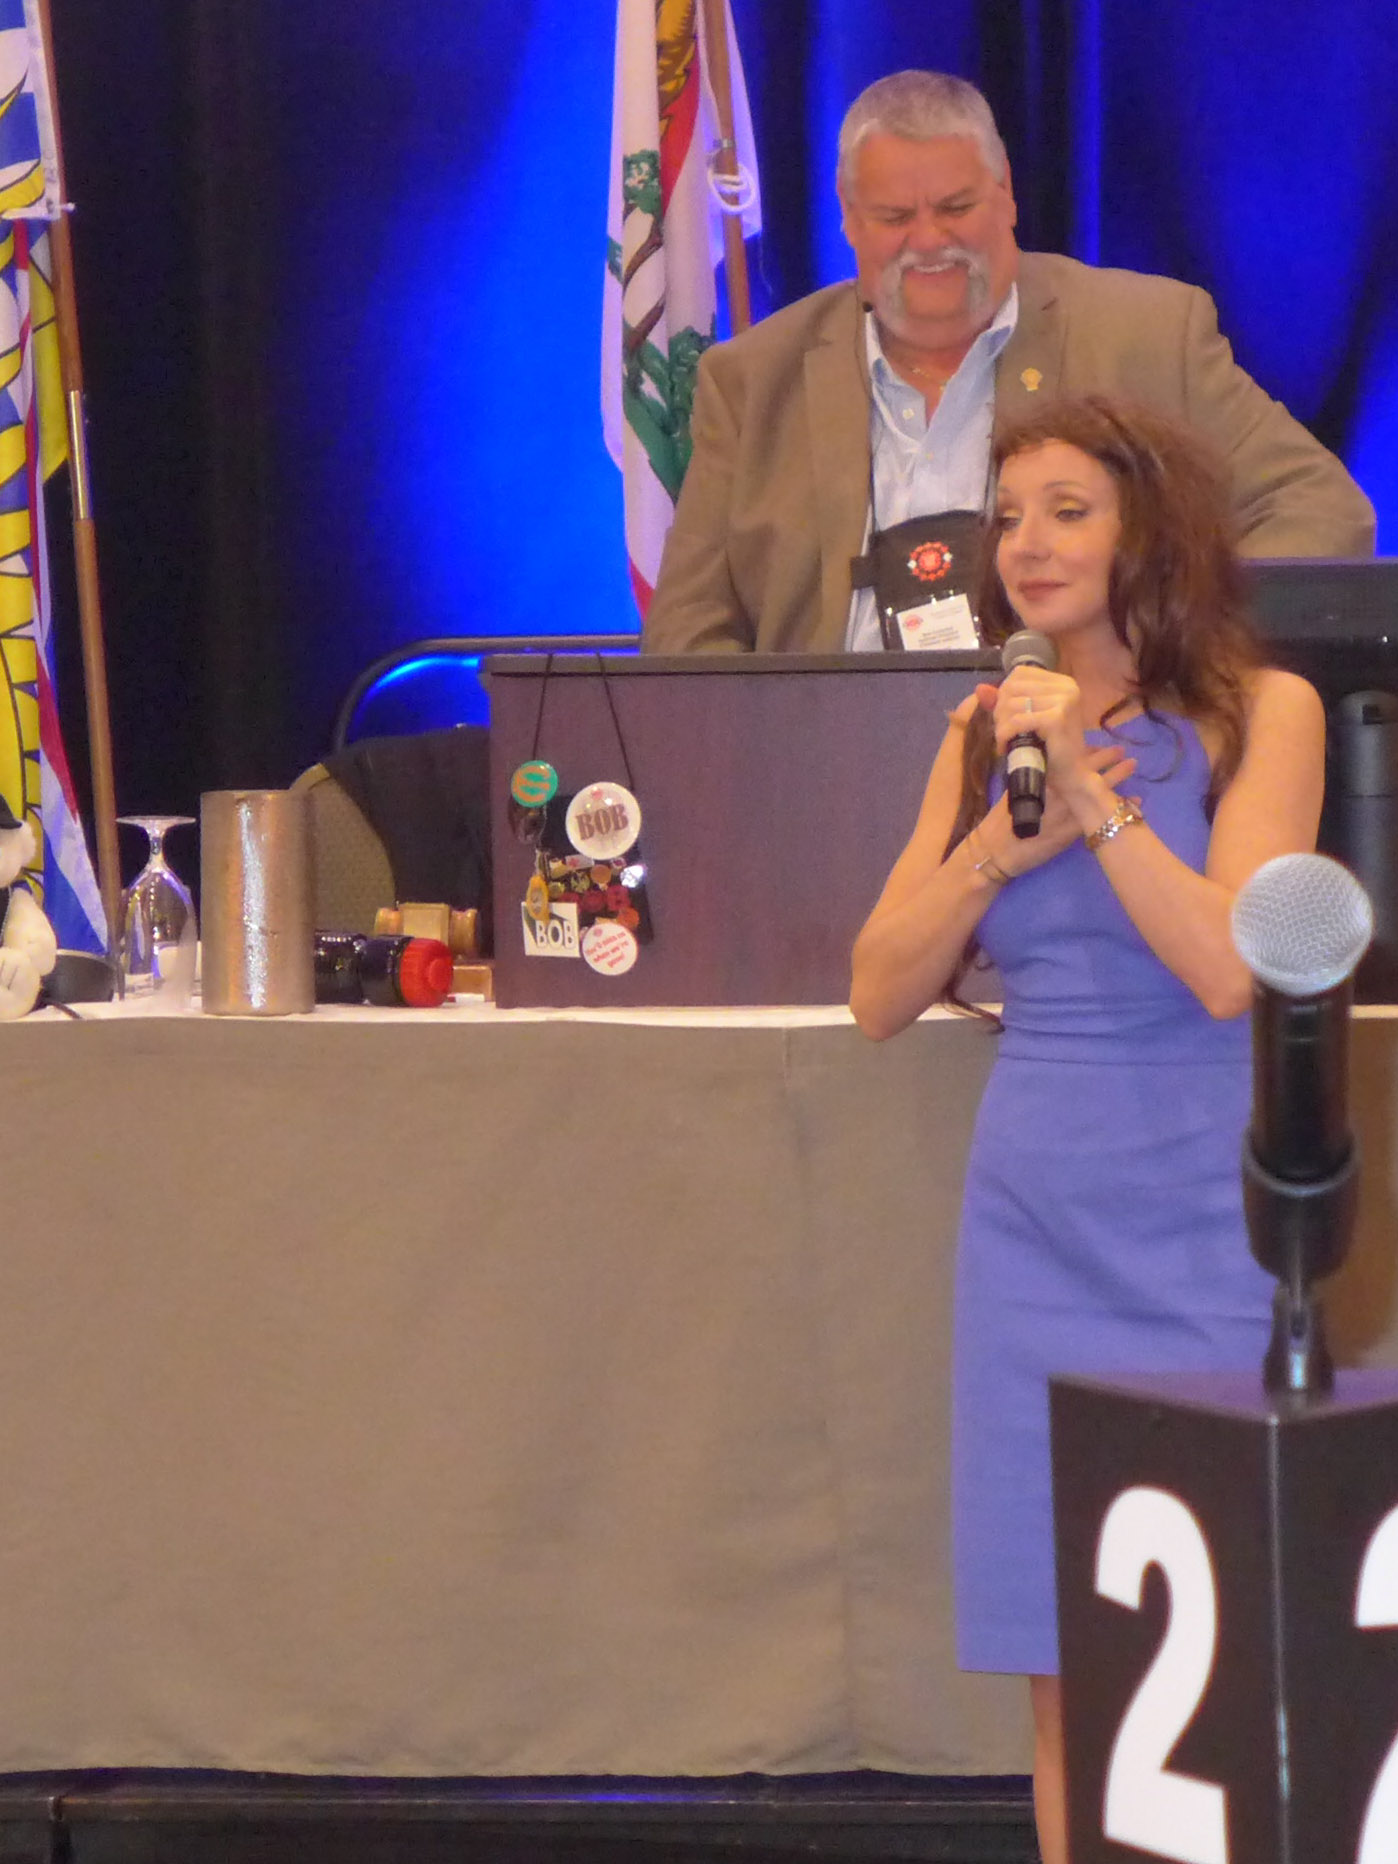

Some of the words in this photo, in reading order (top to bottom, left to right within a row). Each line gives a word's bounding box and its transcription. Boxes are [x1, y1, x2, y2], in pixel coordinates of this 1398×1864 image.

[575, 803, 629, 841] BOB
[535, 918, 577, 949] BOB
[1094, 1486, 1229, 1864] 2
